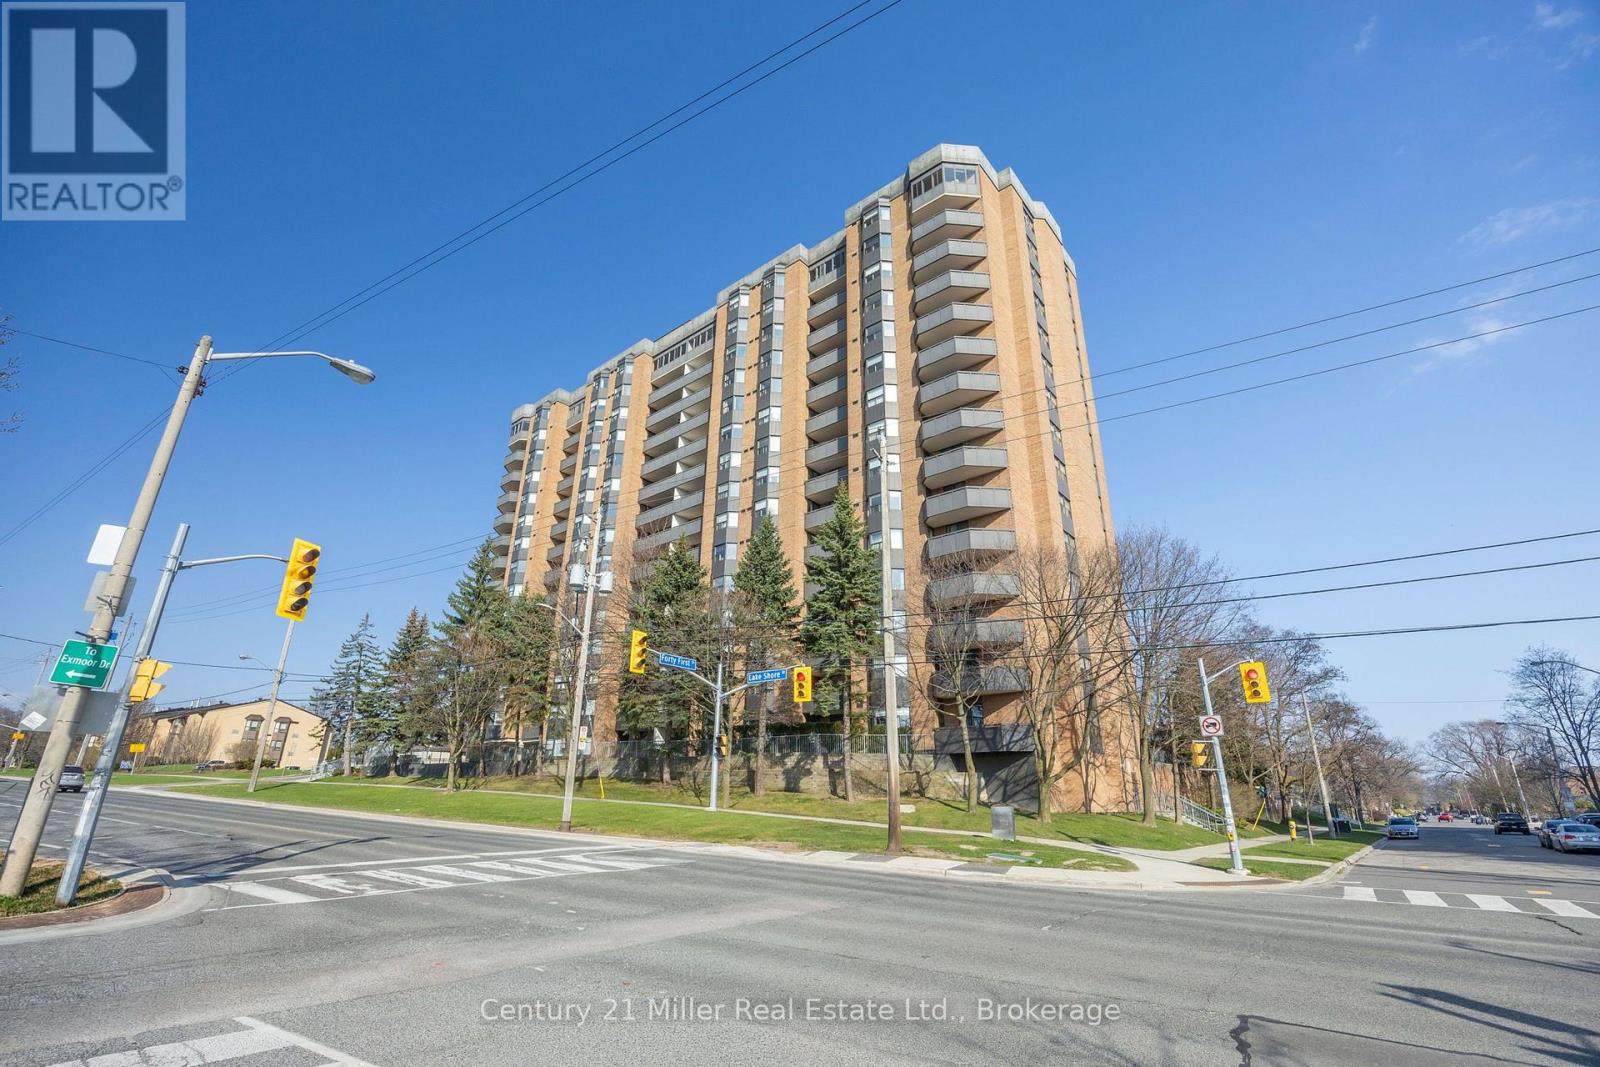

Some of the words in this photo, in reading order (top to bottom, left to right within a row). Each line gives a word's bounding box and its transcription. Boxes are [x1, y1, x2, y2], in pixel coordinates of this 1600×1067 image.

[85, 646, 97, 656] To
[60, 654, 97, 667] Exmoor
[98, 659, 111, 669] Dr
[661, 654, 677, 665] Forty
[677, 657, 691, 667] First
[748, 673, 762, 682] Lake
[763, 671, 781, 681] Shore
